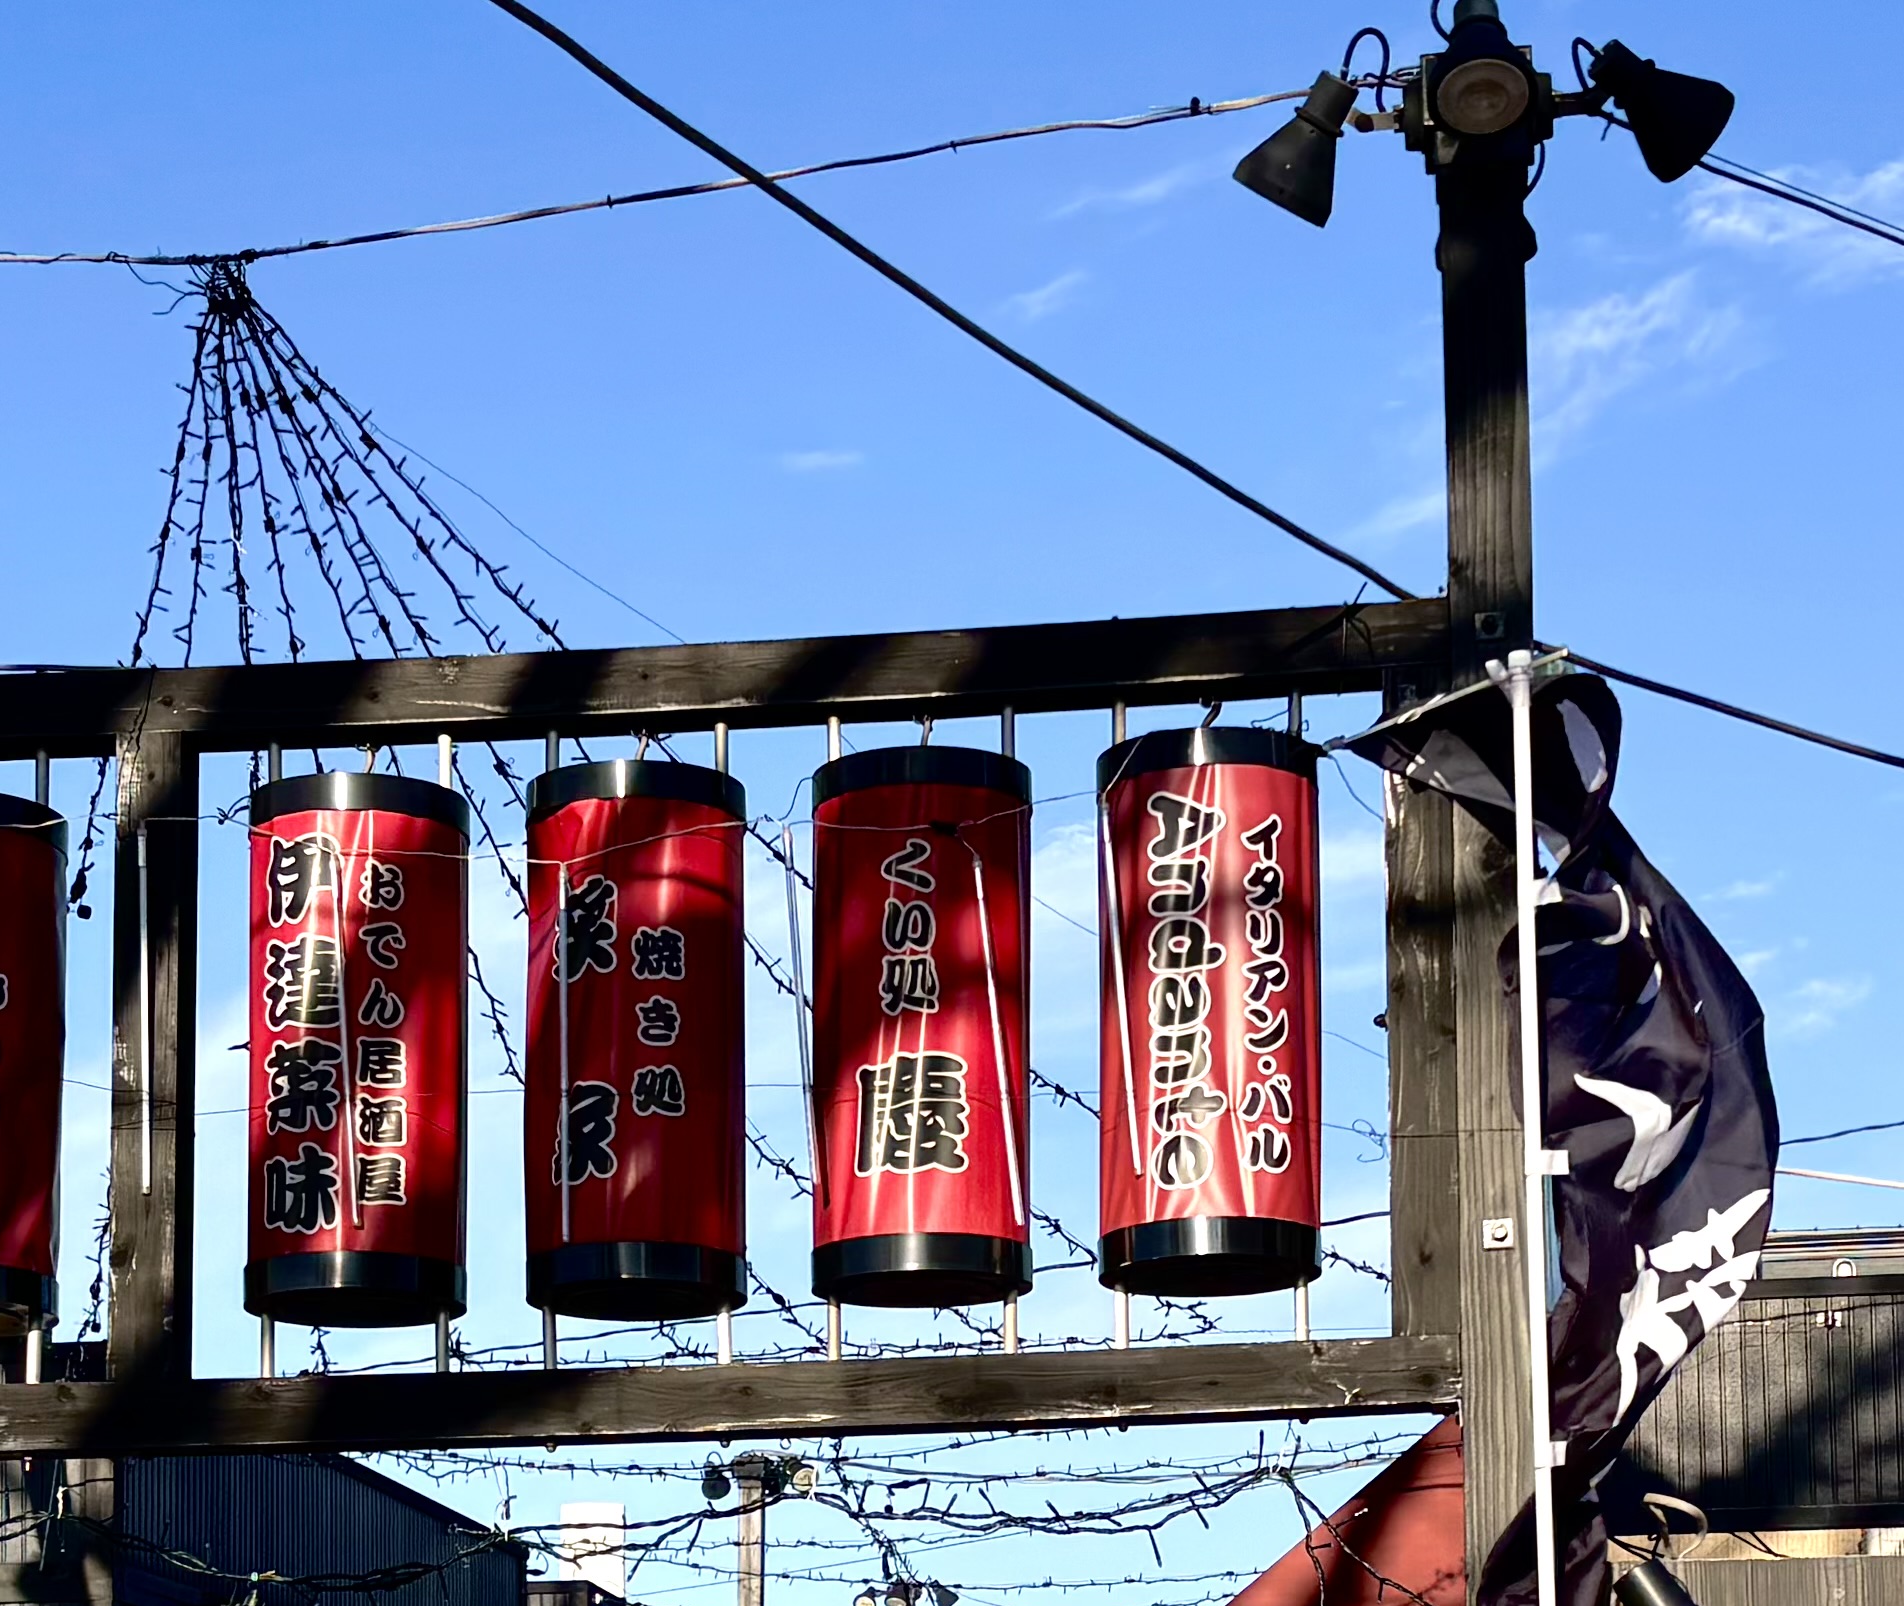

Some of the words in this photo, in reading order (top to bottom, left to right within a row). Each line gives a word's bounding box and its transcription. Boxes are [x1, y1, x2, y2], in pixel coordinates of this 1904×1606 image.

[264, 833, 344, 1233] 伊達菜味
[356, 860, 408, 1205] おでん居酒屋
[632, 926, 685, 1116] 焼き処
[881, 839, 940, 1016] くい処
[1147, 791, 1226, 1191] Andante
[1237, 814, 1292, 1174] イタリアン・バル
[854, 1050, 969, 1178] 慶
